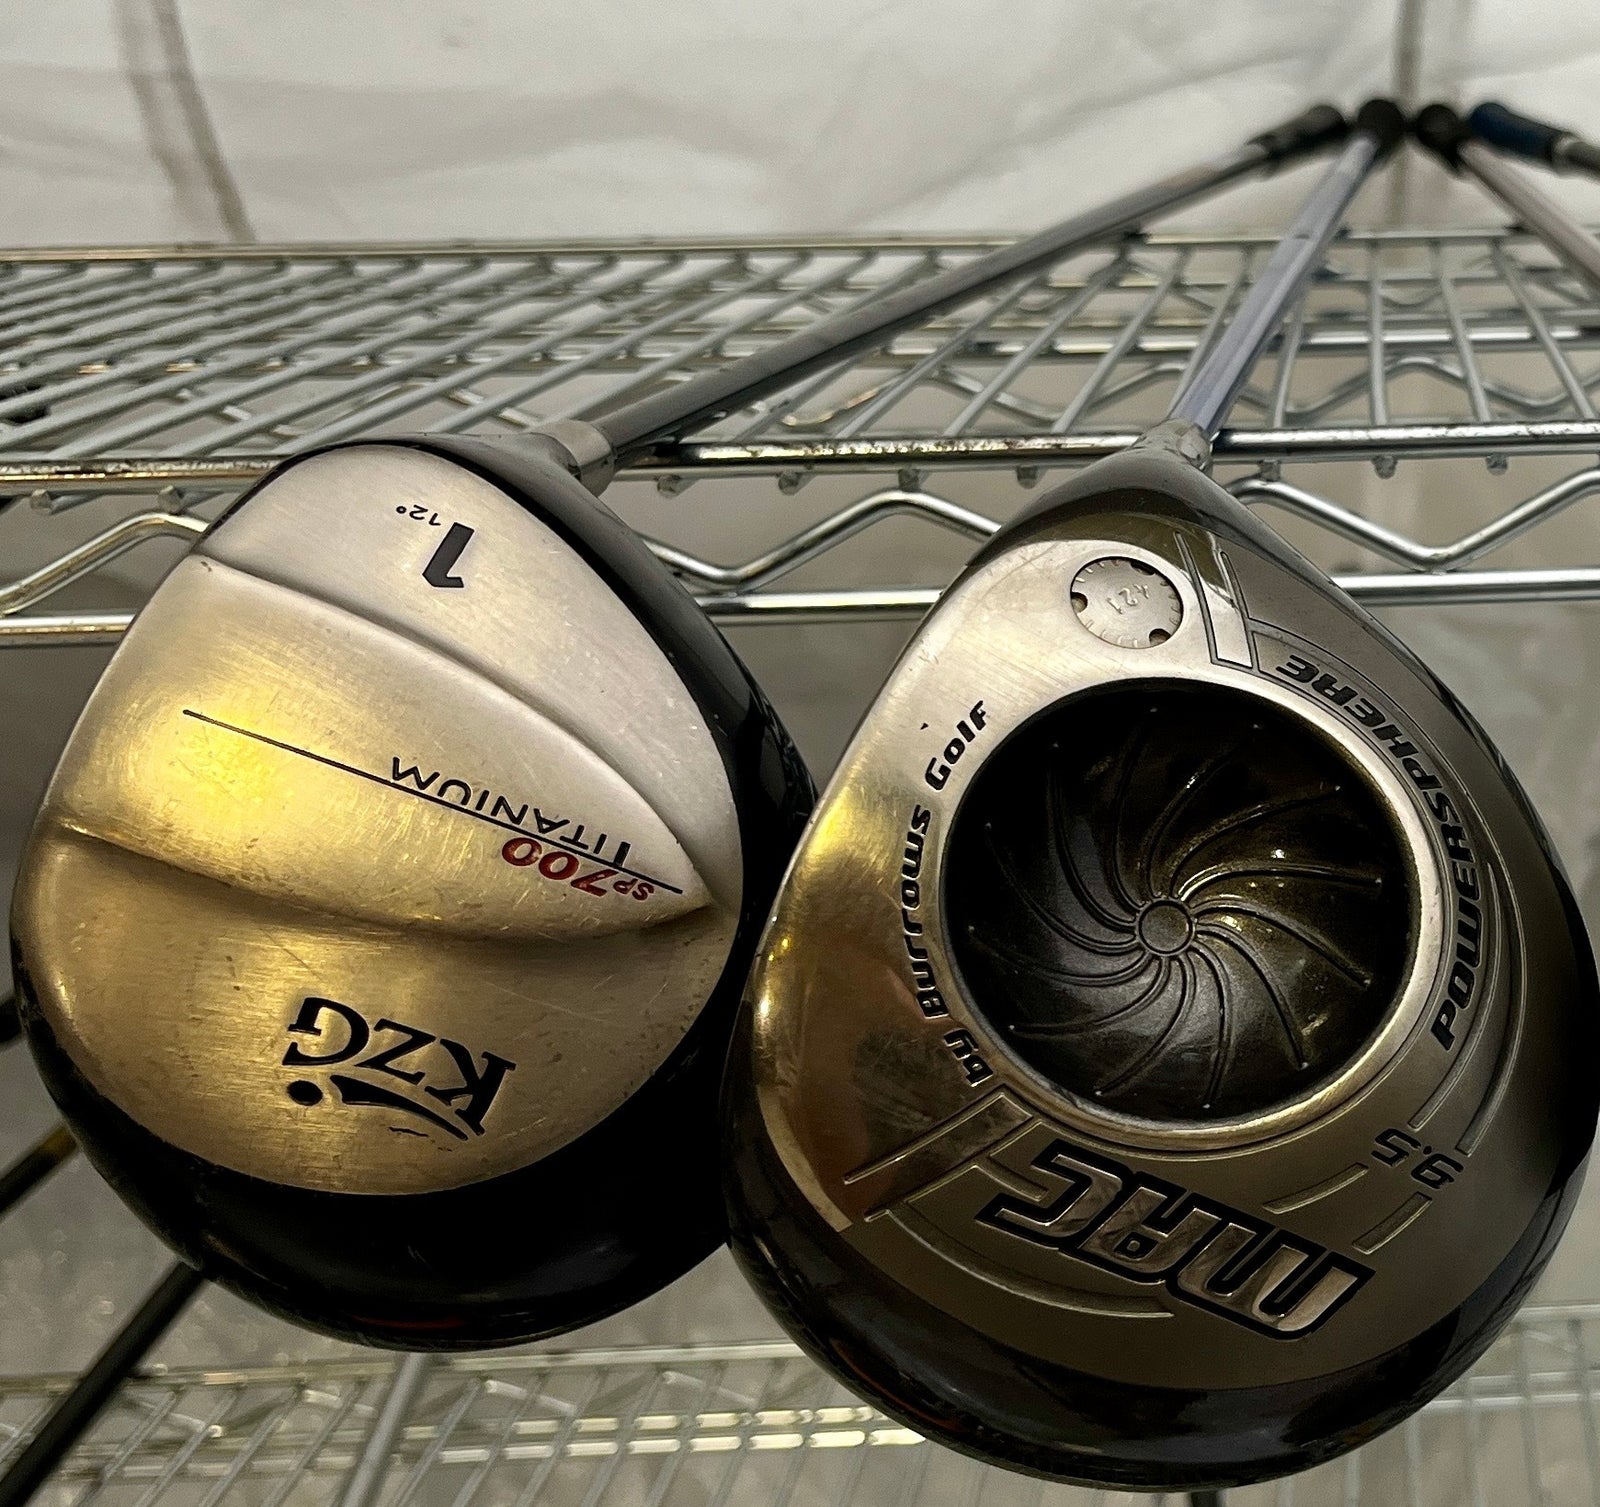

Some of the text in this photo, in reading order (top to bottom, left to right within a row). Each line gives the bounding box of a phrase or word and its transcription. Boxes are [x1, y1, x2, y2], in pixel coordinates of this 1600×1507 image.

[421, 521, 475, 588] 1
[391, 756, 631, 868] TITANIUM
[1275, 653, 1483, 1052] POWERSPHERE
[901, 700, 995, 1088] by Burrows Golf
[282, 997, 517, 1136] KZG
[1371, 1128, 1464, 1190] 9.5
[974, 1138, 1376, 1341] MAC
